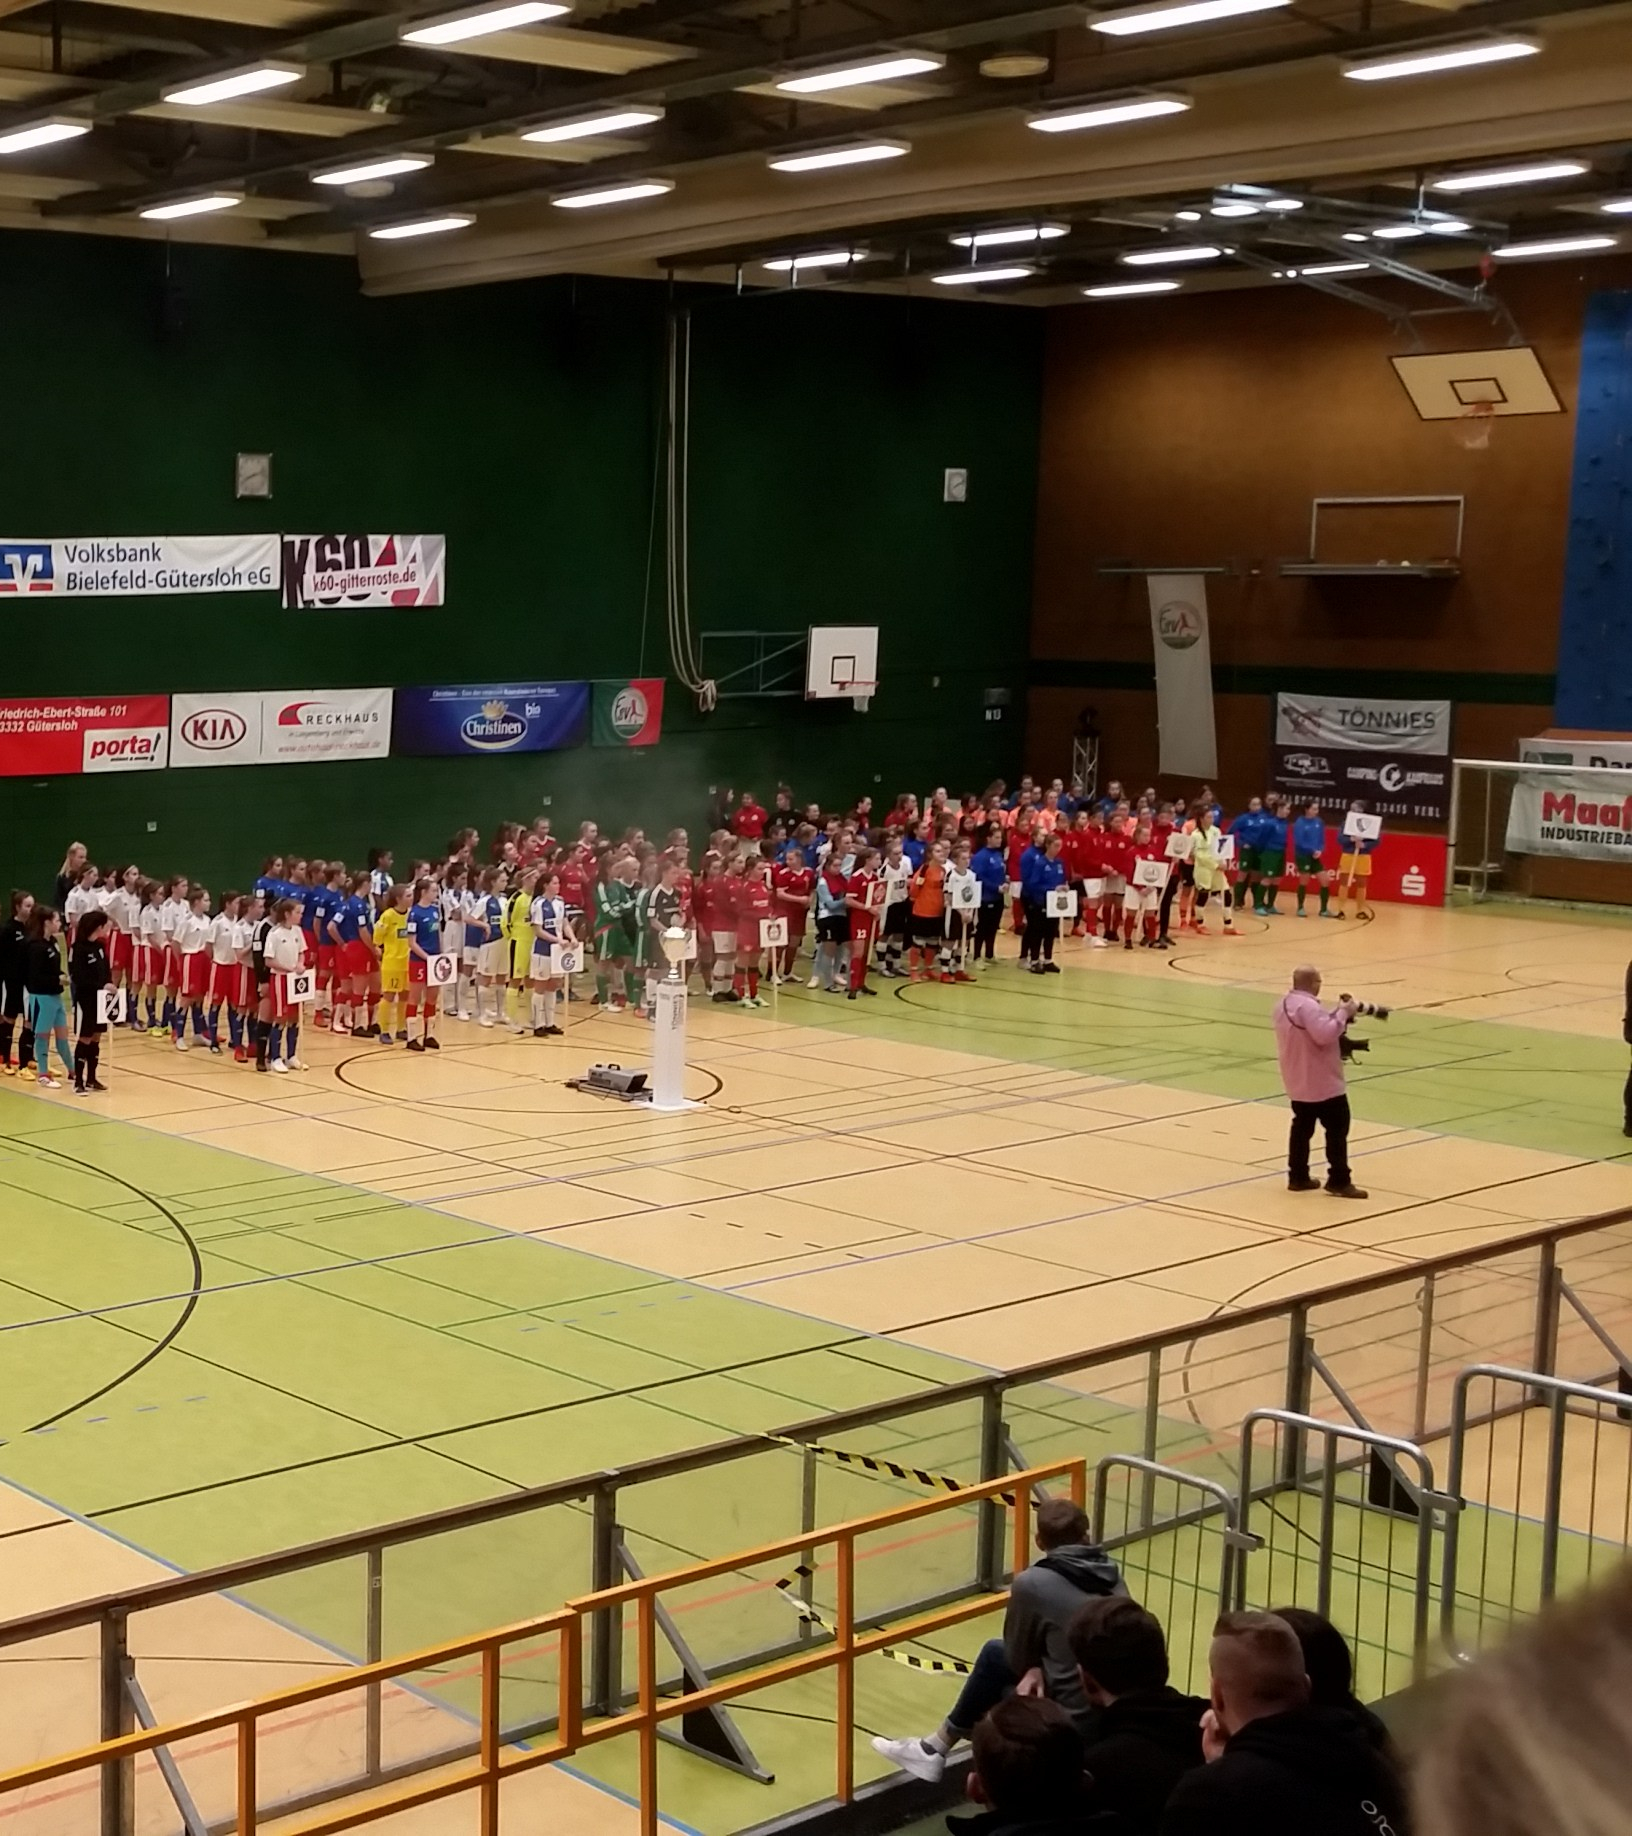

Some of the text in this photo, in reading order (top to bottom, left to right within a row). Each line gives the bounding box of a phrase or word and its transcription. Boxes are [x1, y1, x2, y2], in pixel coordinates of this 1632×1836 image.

[65, 542, 162, 563] Volksbank
[67, 567, 271, 591] Bielefeld-Gütersloh eG
[313, 566, 417, 594] k60-gitterroste.de
[110, 705, 126, 716] 101
[306, 712, 379, 725] RECKHAUS
[1338, 706, 1436, 729] TÖNNIES
[27, 719, 78, 732] Gütersloh
[193, 719, 235, 740] KIA
[466, 720, 522, 736] Christinen
